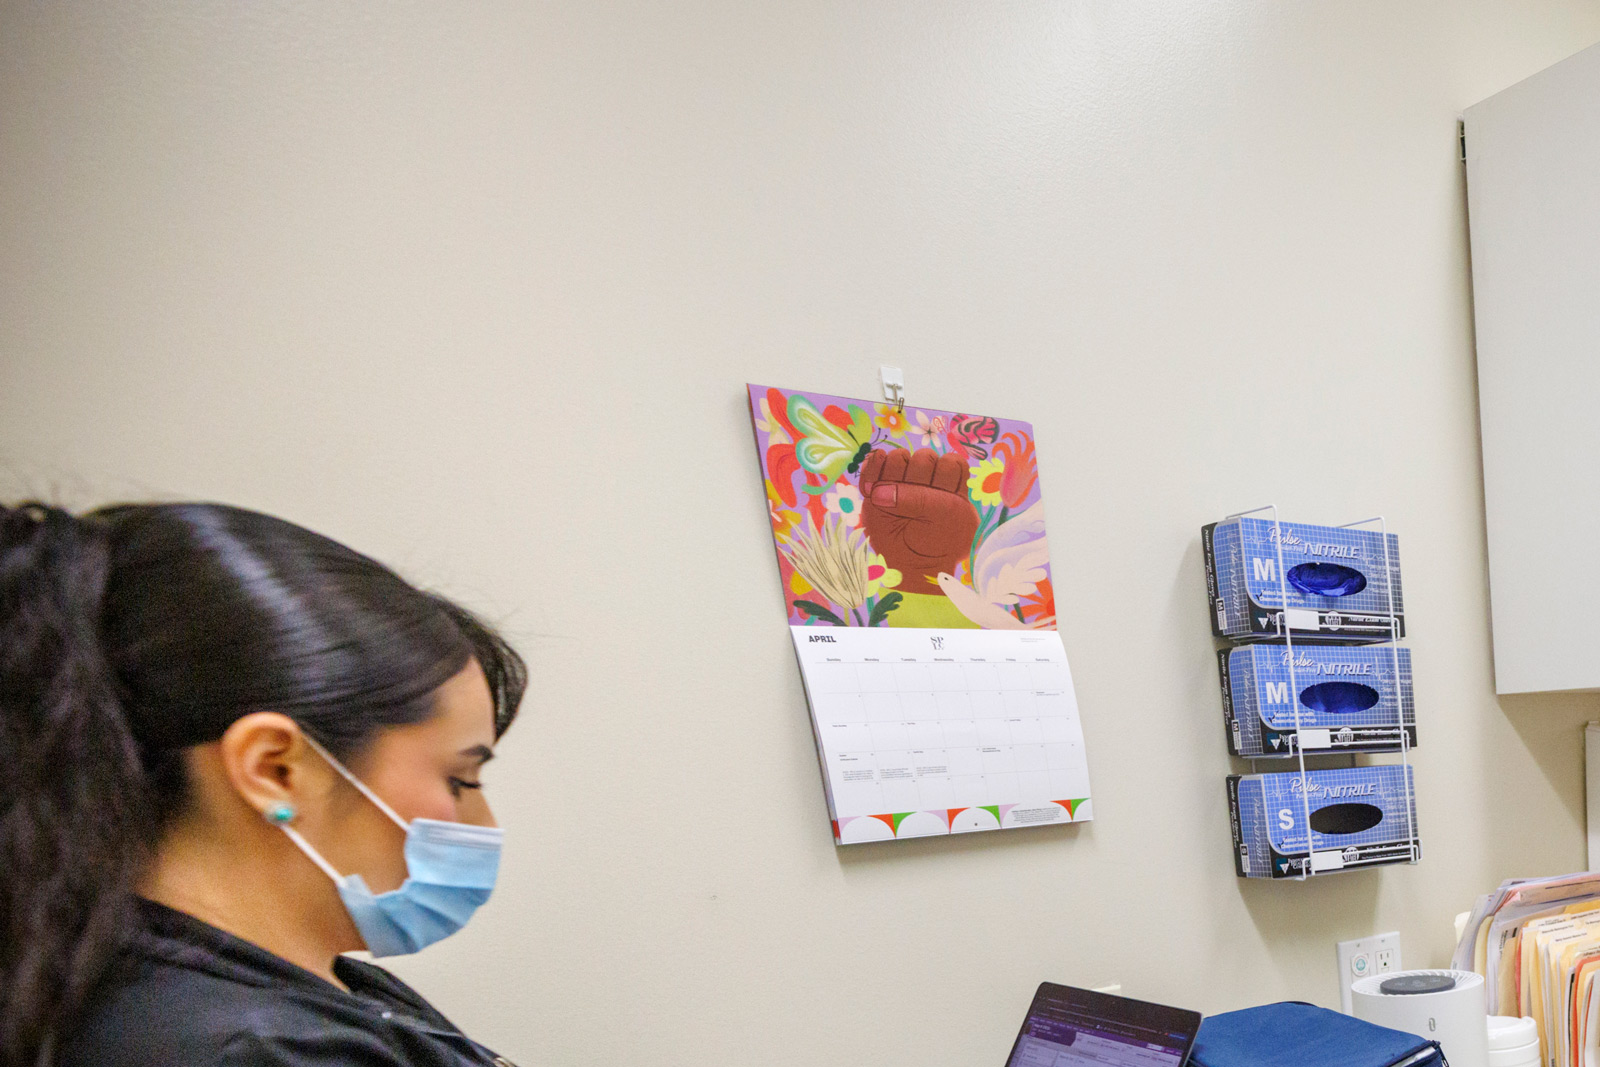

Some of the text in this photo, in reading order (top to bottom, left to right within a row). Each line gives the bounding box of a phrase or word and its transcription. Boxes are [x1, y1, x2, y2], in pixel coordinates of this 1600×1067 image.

[1303, 543, 1360, 559] NITRILE
[1252, 557, 1277, 582] M
[808, 635, 837, 643] APRIL
[1317, 663, 1372, 676] NITRILE
[1265, 681, 1289, 704] M
[1323, 783, 1377, 799] NITRILE
[1278, 808, 1295, 830] S
